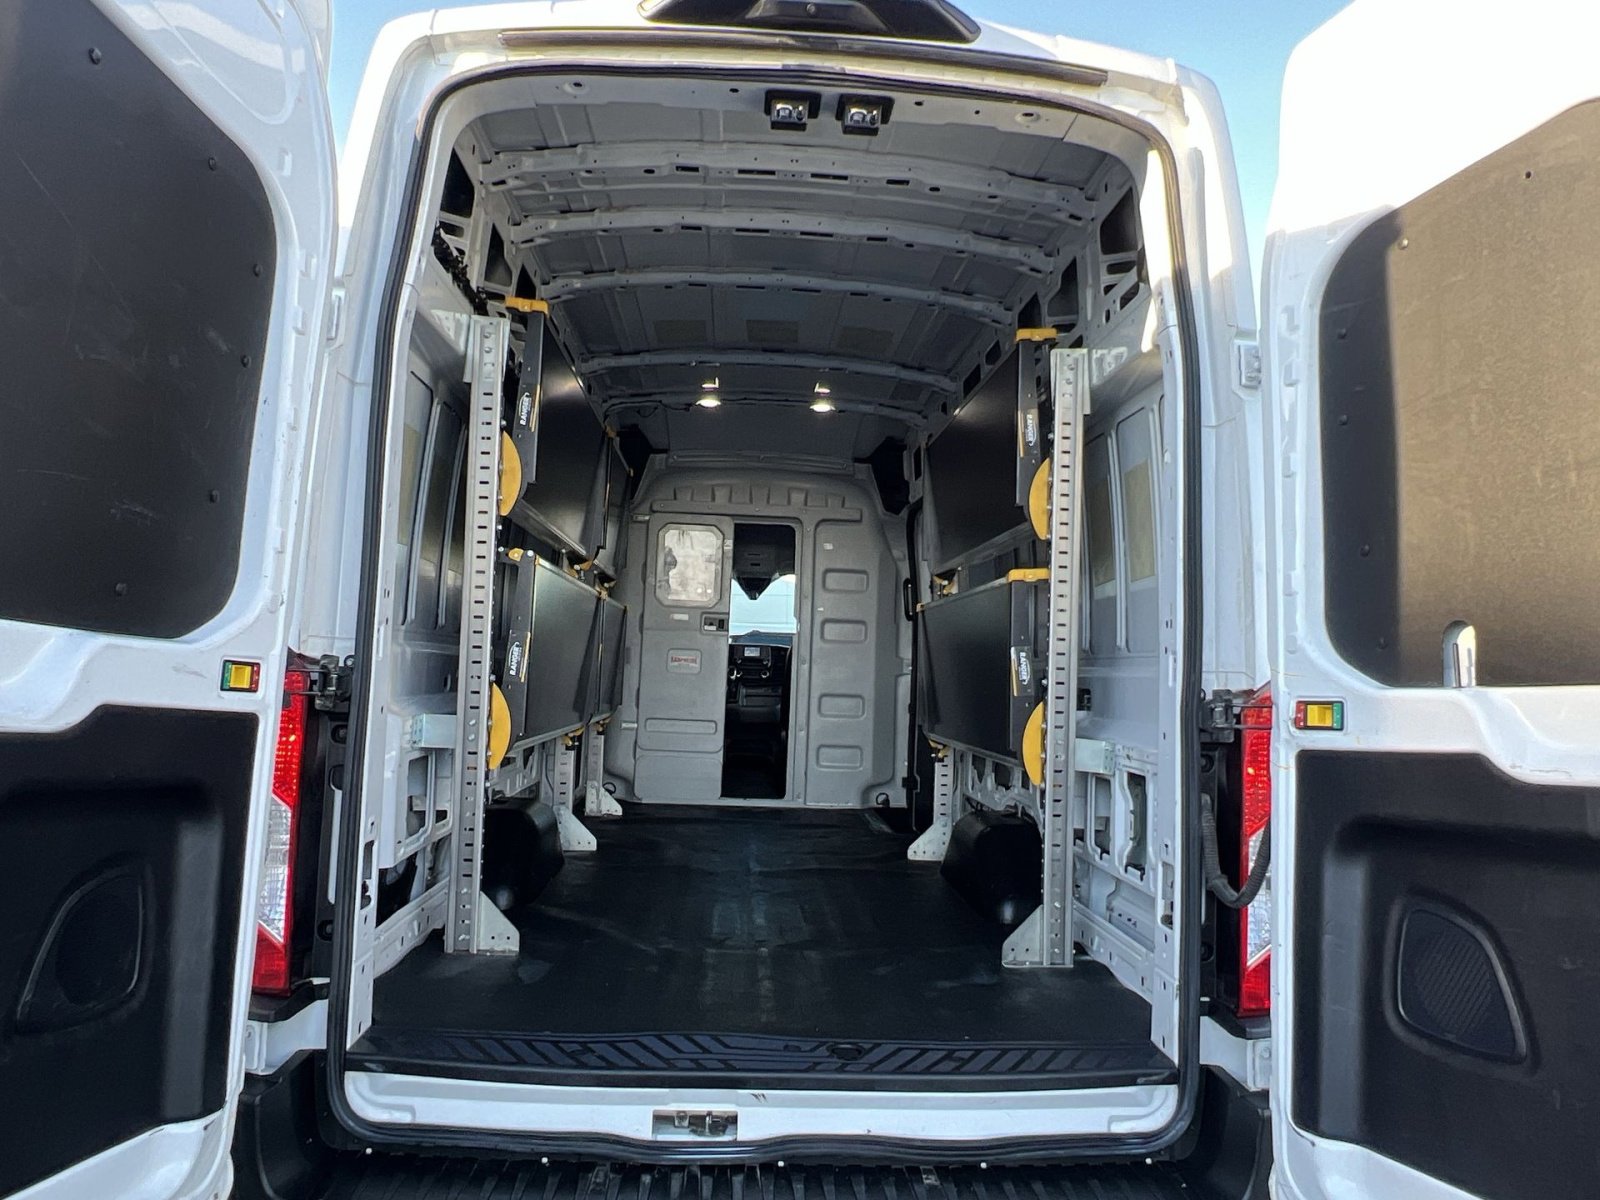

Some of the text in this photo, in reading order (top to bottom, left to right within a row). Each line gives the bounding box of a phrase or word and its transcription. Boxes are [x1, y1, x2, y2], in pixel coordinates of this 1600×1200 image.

[520, 397, 530, 426] RANGER
[510, 646, 520, 676] RANGER
[1020, 652, 1028, 680] RANGER
